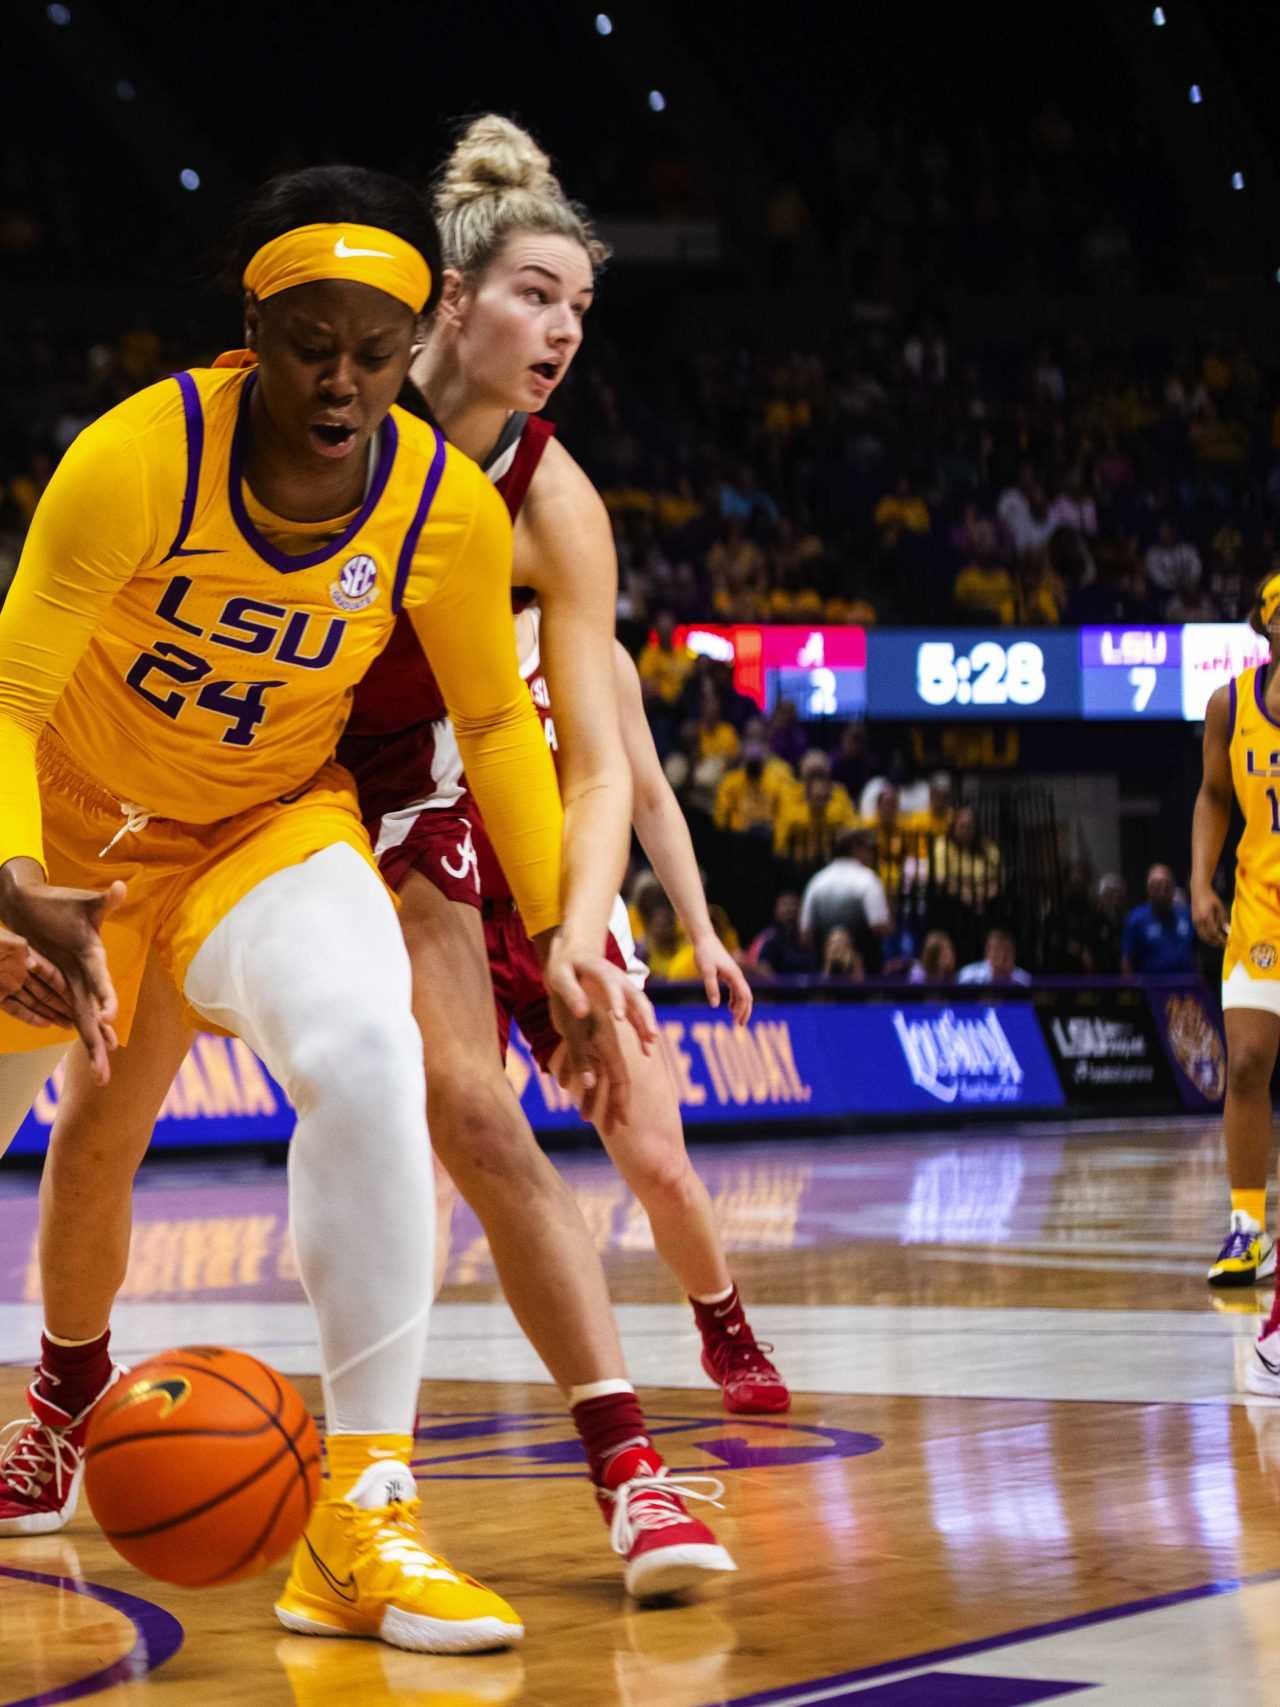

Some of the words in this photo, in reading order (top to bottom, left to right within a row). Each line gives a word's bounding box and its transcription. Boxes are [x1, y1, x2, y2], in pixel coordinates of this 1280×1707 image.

[154, 575, 348, 669] LSU
[1100, 631, 1167, 665] LSU
[124, 640, 289, 746] 24
[917, 641, 1046, 705] 5:28
[1129, 667, 1157, 712] 7
